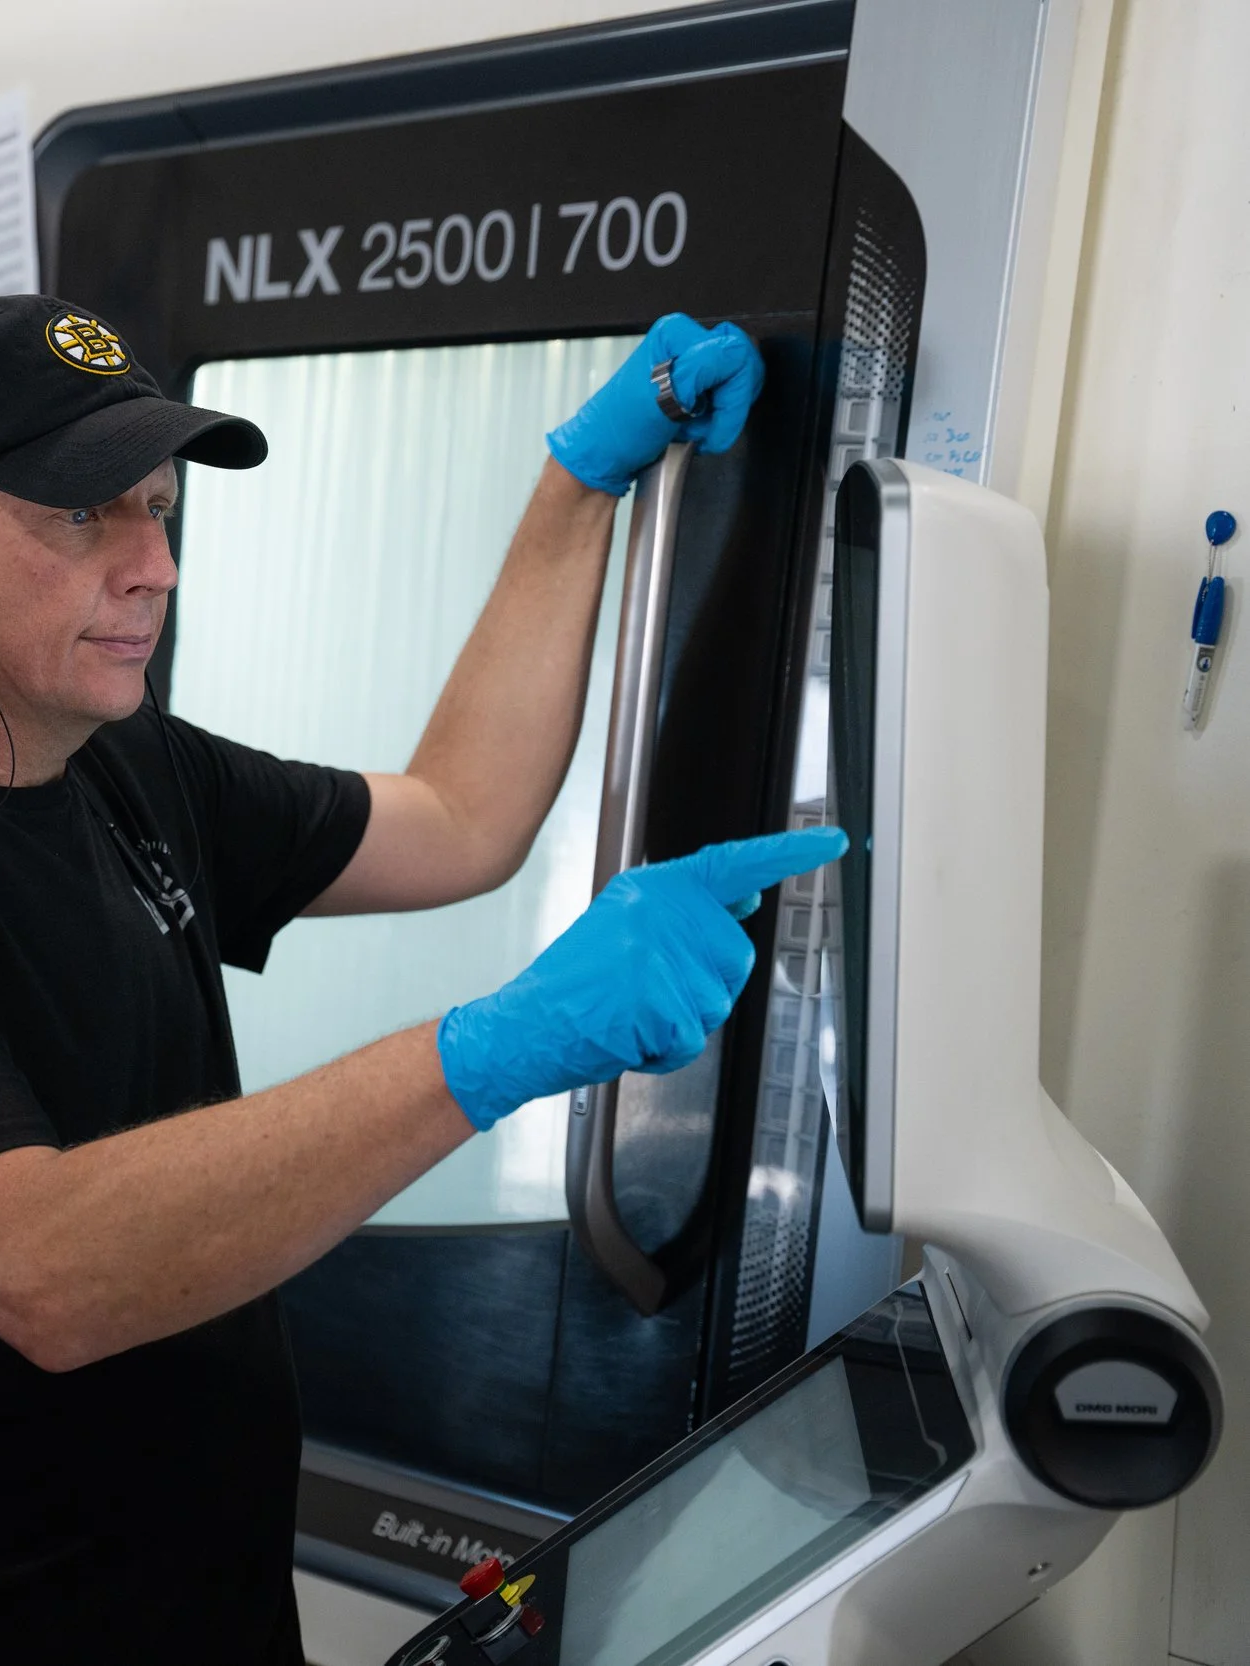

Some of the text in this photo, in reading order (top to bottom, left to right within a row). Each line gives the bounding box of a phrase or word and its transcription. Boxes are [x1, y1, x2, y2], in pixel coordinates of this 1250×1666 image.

[203, 225, 345, 305] NLX
[1075, 1403, 1158, 1416] DMG MORI
[371, 1510, 453, 1556] Built-in
